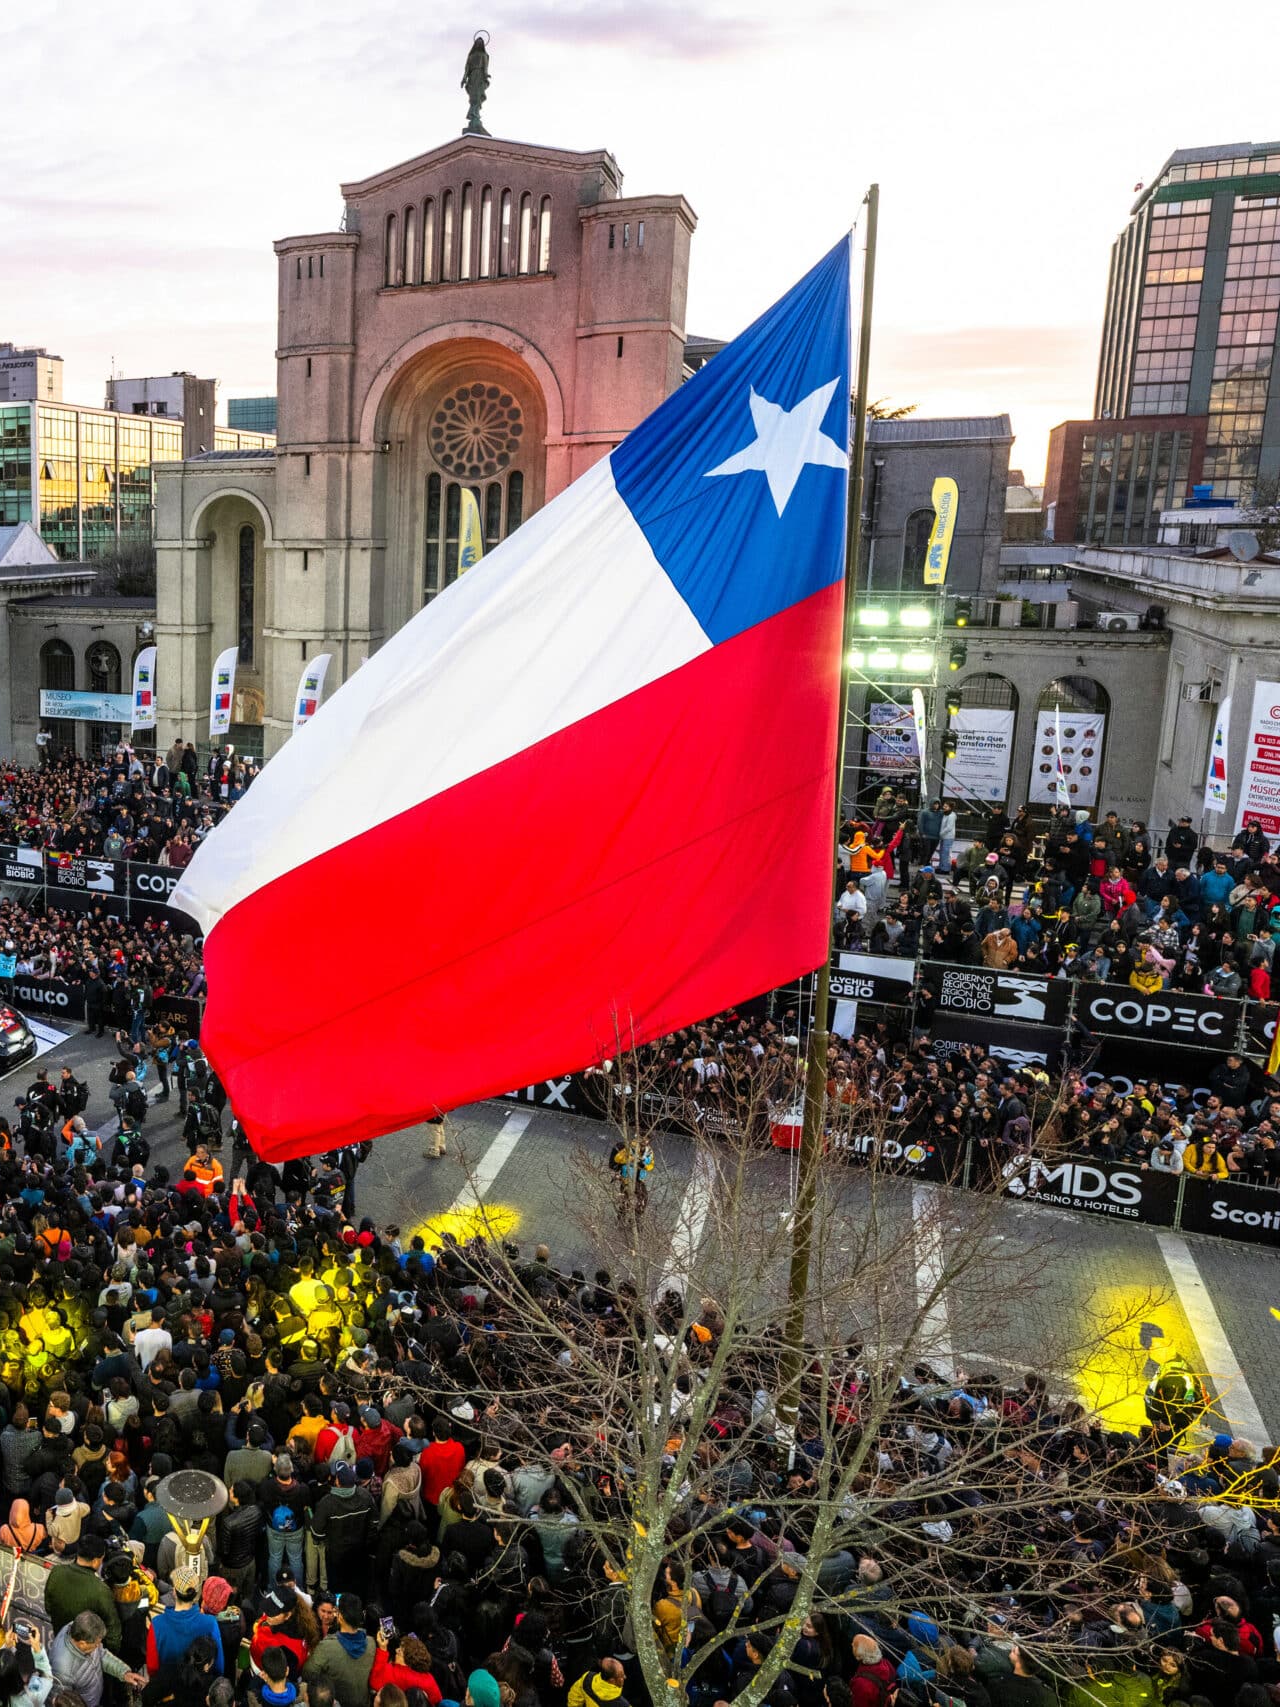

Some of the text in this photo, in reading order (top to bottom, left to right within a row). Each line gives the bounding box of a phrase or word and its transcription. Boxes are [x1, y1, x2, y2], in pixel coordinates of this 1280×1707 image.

[45, 692, 72, 701] MUSEO
[44, 708, 81, 717] RELIGIOSO
[957, 741, 1007, 749] ransforman
[987, 735, 1004, 743] Que
[943, 971, 995, 985] GOBIERNO
[943, 979, 992, 993] REGIONAL
[976, 991, 991, 1001] DEL
[1089, 997, 1224, 1036] COPEC
[1028, 1157, 1142, 1206] MDS
[1027, 1190, 1140, 1218] CASINO & HOTELES
